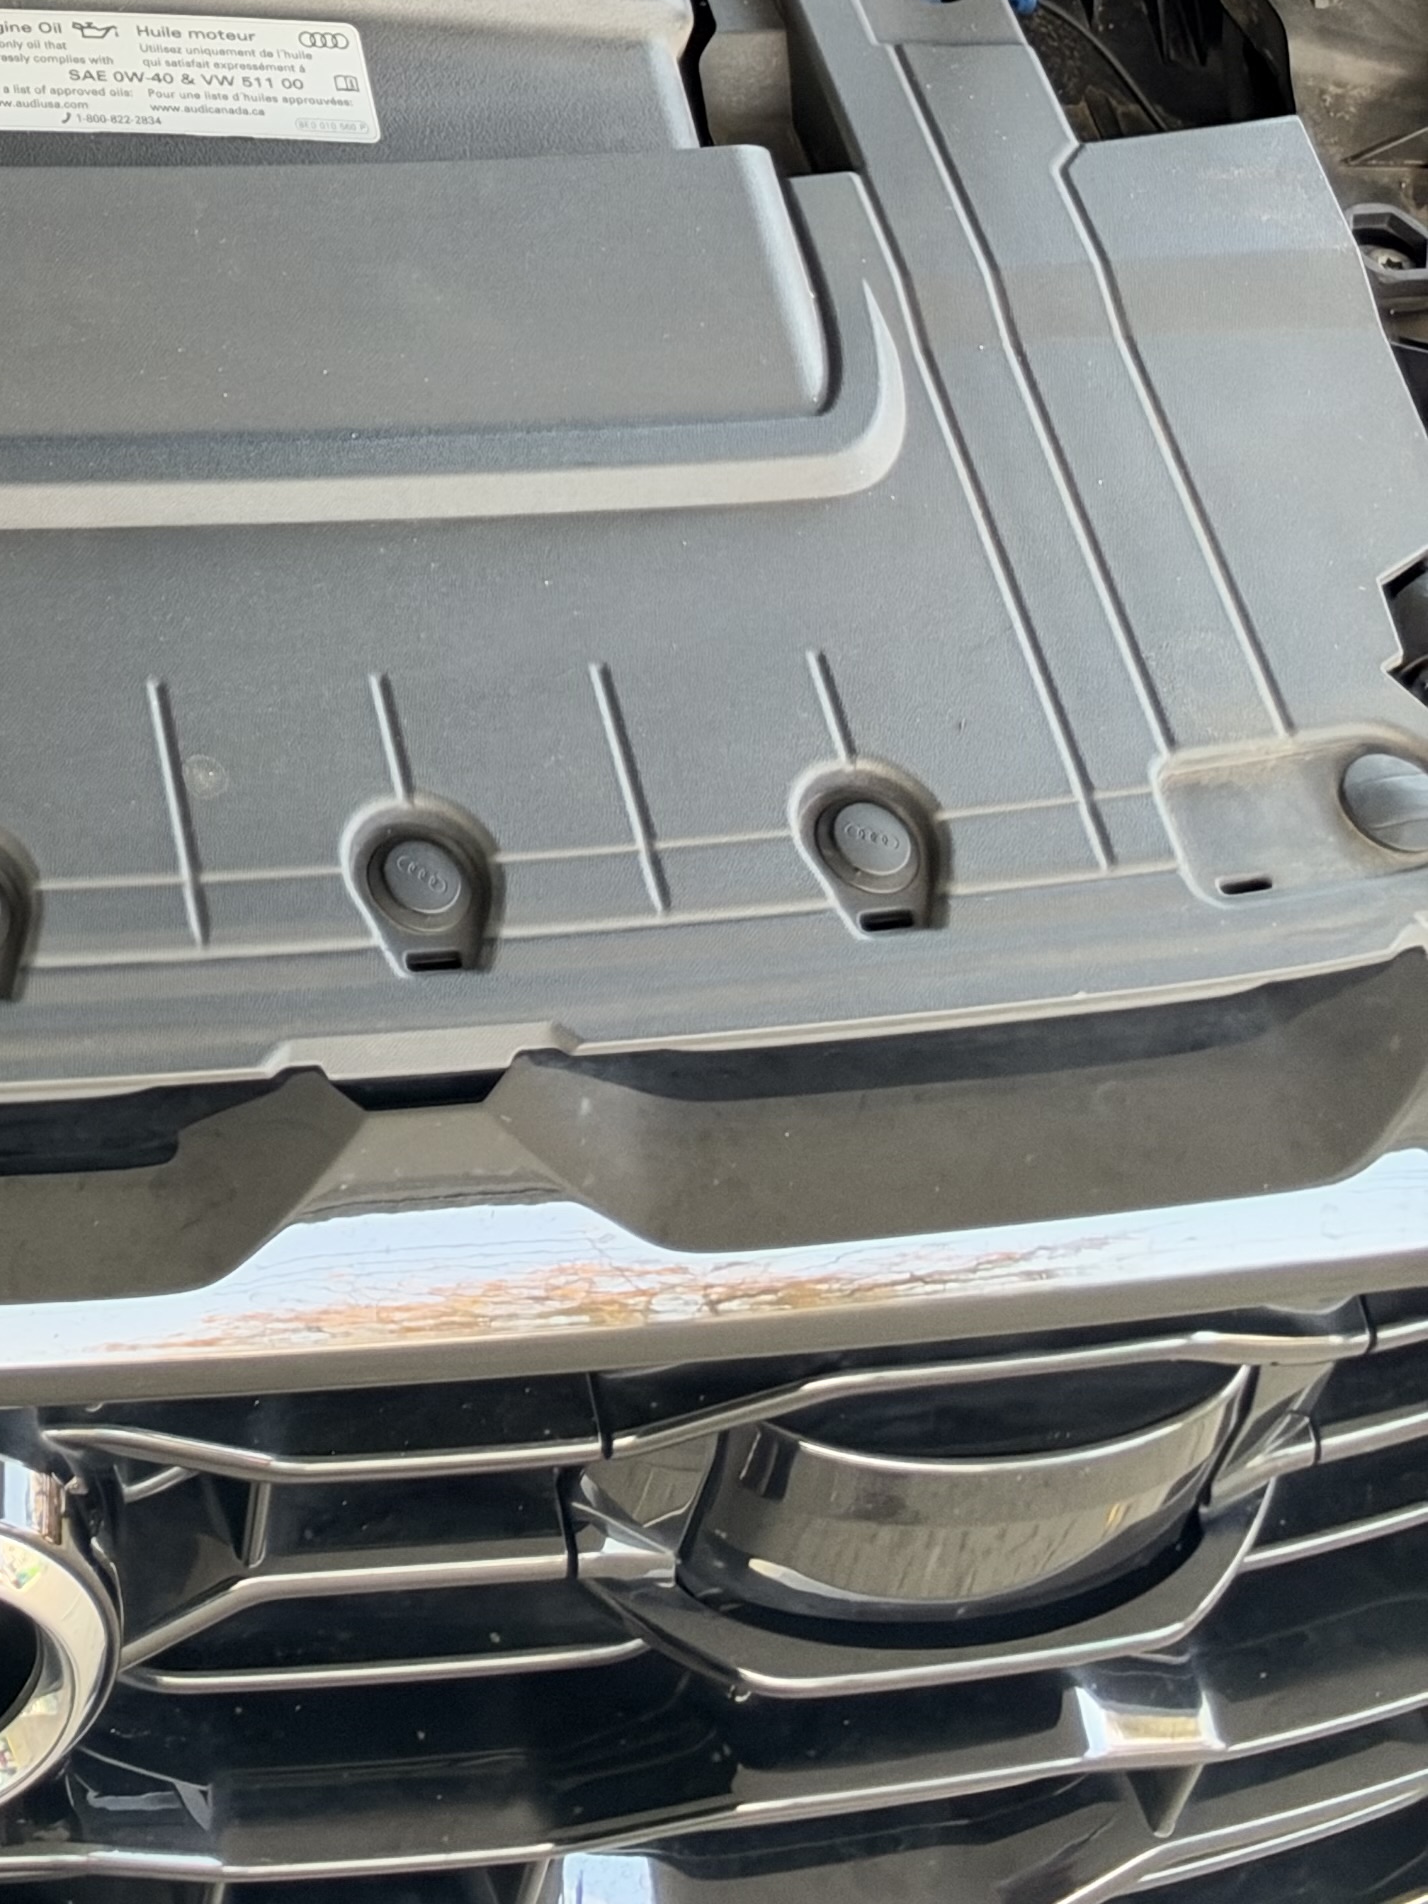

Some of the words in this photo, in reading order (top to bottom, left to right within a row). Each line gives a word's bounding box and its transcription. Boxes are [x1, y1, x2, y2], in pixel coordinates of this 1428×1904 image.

[38, 22, 63, 34] Oil
[136, 25, 182, 39] Huile
[188, 28, 256, 42] moteur
[27, 39, 41, 50] oil
[44, 40, 67, 50] that
[139, 43, 182, 55] Utilisez
[185, 46, 256, 58] uniquement
[259, 48, 274, 58] de
[33, 54, 86, 65] complies
[89, 55, 114, 65] with
[142, 58, 161, 68] qui
[164, 58, 210, 69] satisfait
[214, 61, 295, 74] expressément
[69, 69, 107, 82] SAE
[113, 70, 174, 84] 0W-40
[181, 73, 195, 85] &
[200, 74, 235, 87] VW
[242, 76, 273, 89] 511
[281, 78, 304, 90] 00
[13, 84, 31, 94] list
[34, 85, 46, 95] of
[49, 86, 105, 97] approved
[109, 88, 133, 97] oils:
[148, 88, 175, 99] Pour
[179, 91, 201, 100] une
[204, 90, 229, 101] liste
[150, 103, 265, 116] www.audicanada.ca
[77, 113, 162, 125] 1-800-822-2834
